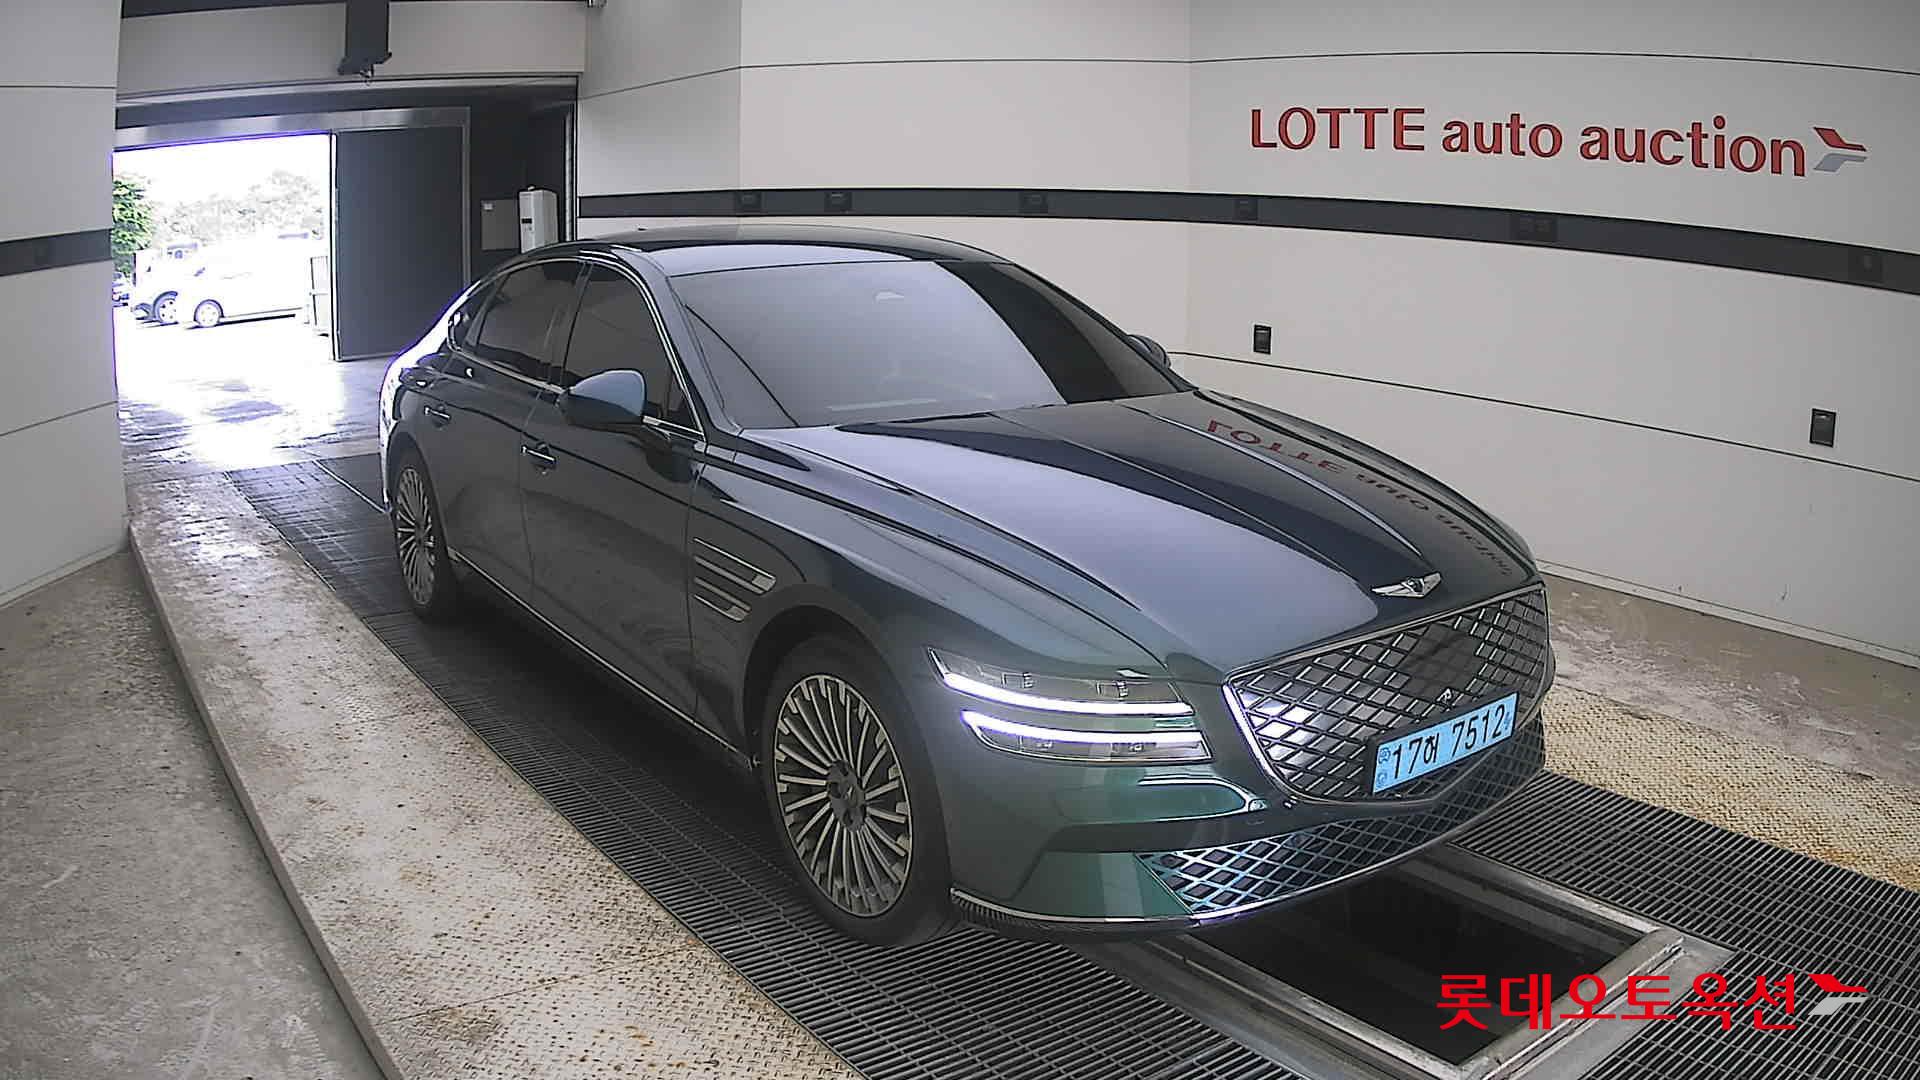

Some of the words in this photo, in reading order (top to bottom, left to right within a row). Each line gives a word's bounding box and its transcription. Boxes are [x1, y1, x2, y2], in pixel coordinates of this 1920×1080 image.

[1250, 107, 1426, 151] LOTTE
[1441, 113, 1563, 158] auto
[1579, 115, 1806, 177] auction
[1392, 733, 1440, 779] 17허
[1452, 704, 1506, 757] 7512
